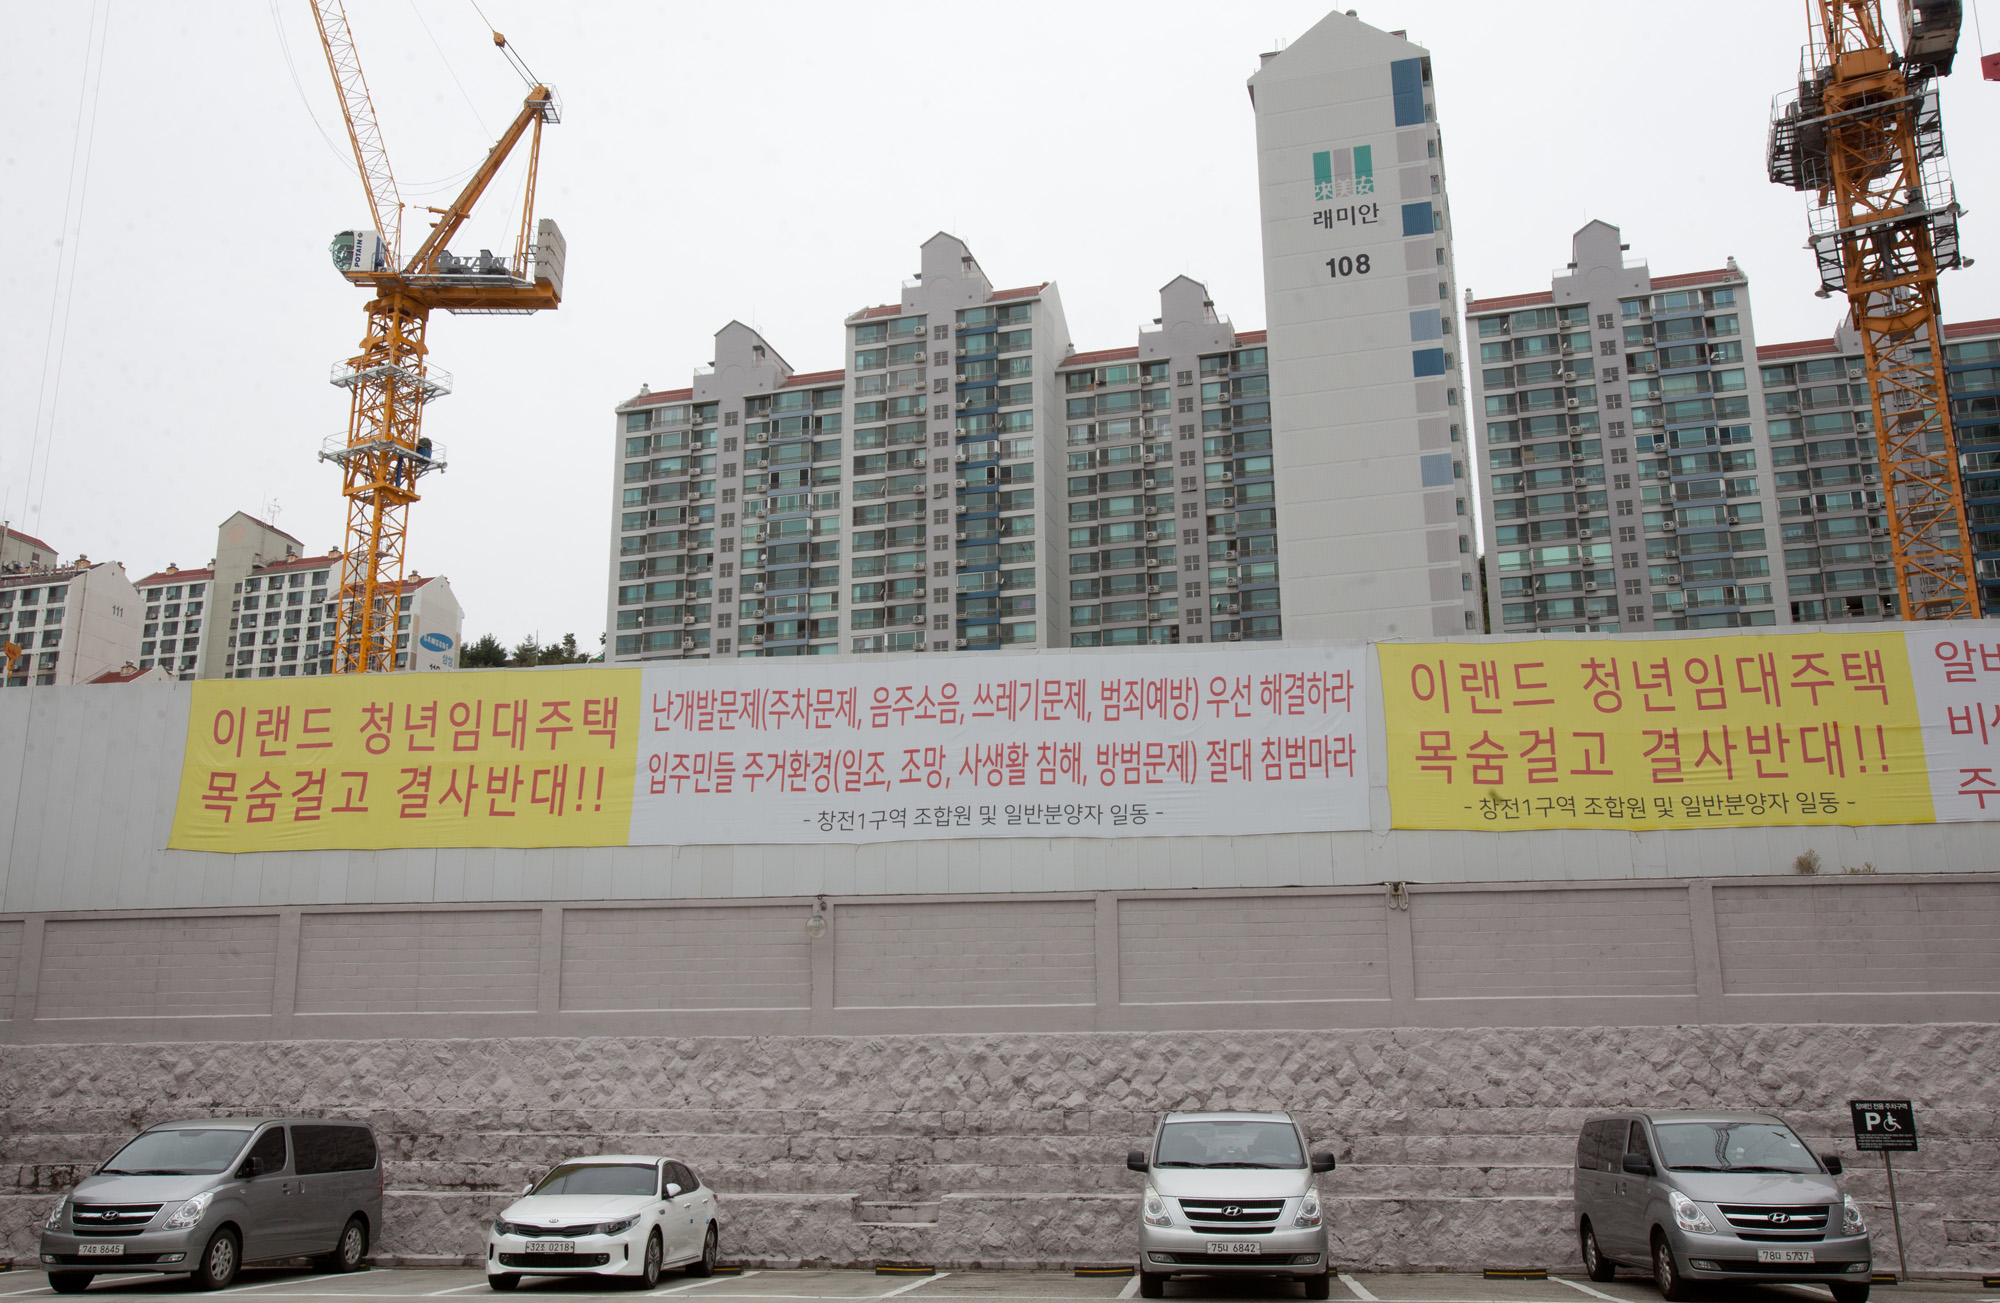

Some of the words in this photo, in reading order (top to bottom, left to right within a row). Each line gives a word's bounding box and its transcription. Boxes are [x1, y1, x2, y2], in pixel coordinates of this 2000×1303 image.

[1313, 203, 1380, 229] 래미안
[354, 239, 363, 268] POTAIN
[1325, 253, 1371, 278] 108
[112, 604, 124, 618] 111
[423, 633, 449, 651] SAMSUNG
[442, 654, 453, 668] 삼성
[1410, 659, 1555, 715] 이랜드
[1580, 648, 1889, 714] 청년임대주택
[869, 682, 965, 729] 음주소음,
[971, 679, 1092, 723] 쓰레기문제,
[1100, 677, 1199, 722] 범죄예방)
[1206, 675, 1252, 718] 우선
[1259, 669, 1355, 716] 해결하라
[213, 705, 334, 759] 이랜드
[359, 696, 619, 755] 청년임대주택
[1947, 702, 2000, 745] 비
[648, 751, 736, 795] 입주민들
[742, 748, 892, 793] 주거환경(일조,
[899, 744, 951, 789] 조망,
[958, 742, 1029, 787] 사생활
[1036, 741, 1088, 787] 침해,
[1096, 740, 1198, 787] 방범문제)
[1206, 738, 1252, 783] 절대
[1261, 733, 1357, 781] 침범마라
[1415, 726, 1614, 785] 목숨걸고
[1641, 720, 1889, 784] 결사반대!!
[201, 767, 369, 824] 목숨걸고
[396, 763, 605, 819] 결사반대!!
[1479, 796, 1577, 820] 창전1구역
[1583, 795, 1647, 819] 조합원
[1653, 796, 1674, 818] 및
[1681, 791, 1790, 818] 일반분양자
[1796, 791, 1840, 815] 일동
[817, 807, 907, 832] 창전1구역
[913, 805, 971, 827] 조합원
[979, 805, 996, 826] 및
[1004, 803, 1104, 826] 일반분양자
[1110, 803, 1149, 826] 일동
[1884, 1102, 1908, 1110] 주차구역
[1864, 1111, 1881, 1131] P
[100, 1244, 120, 1254] 8645
[549, 1243, 570, 1252] 0218
[1232, 1243, 1256, 1253] 6842
[1786, 1250, 1810, 1261] 5737
